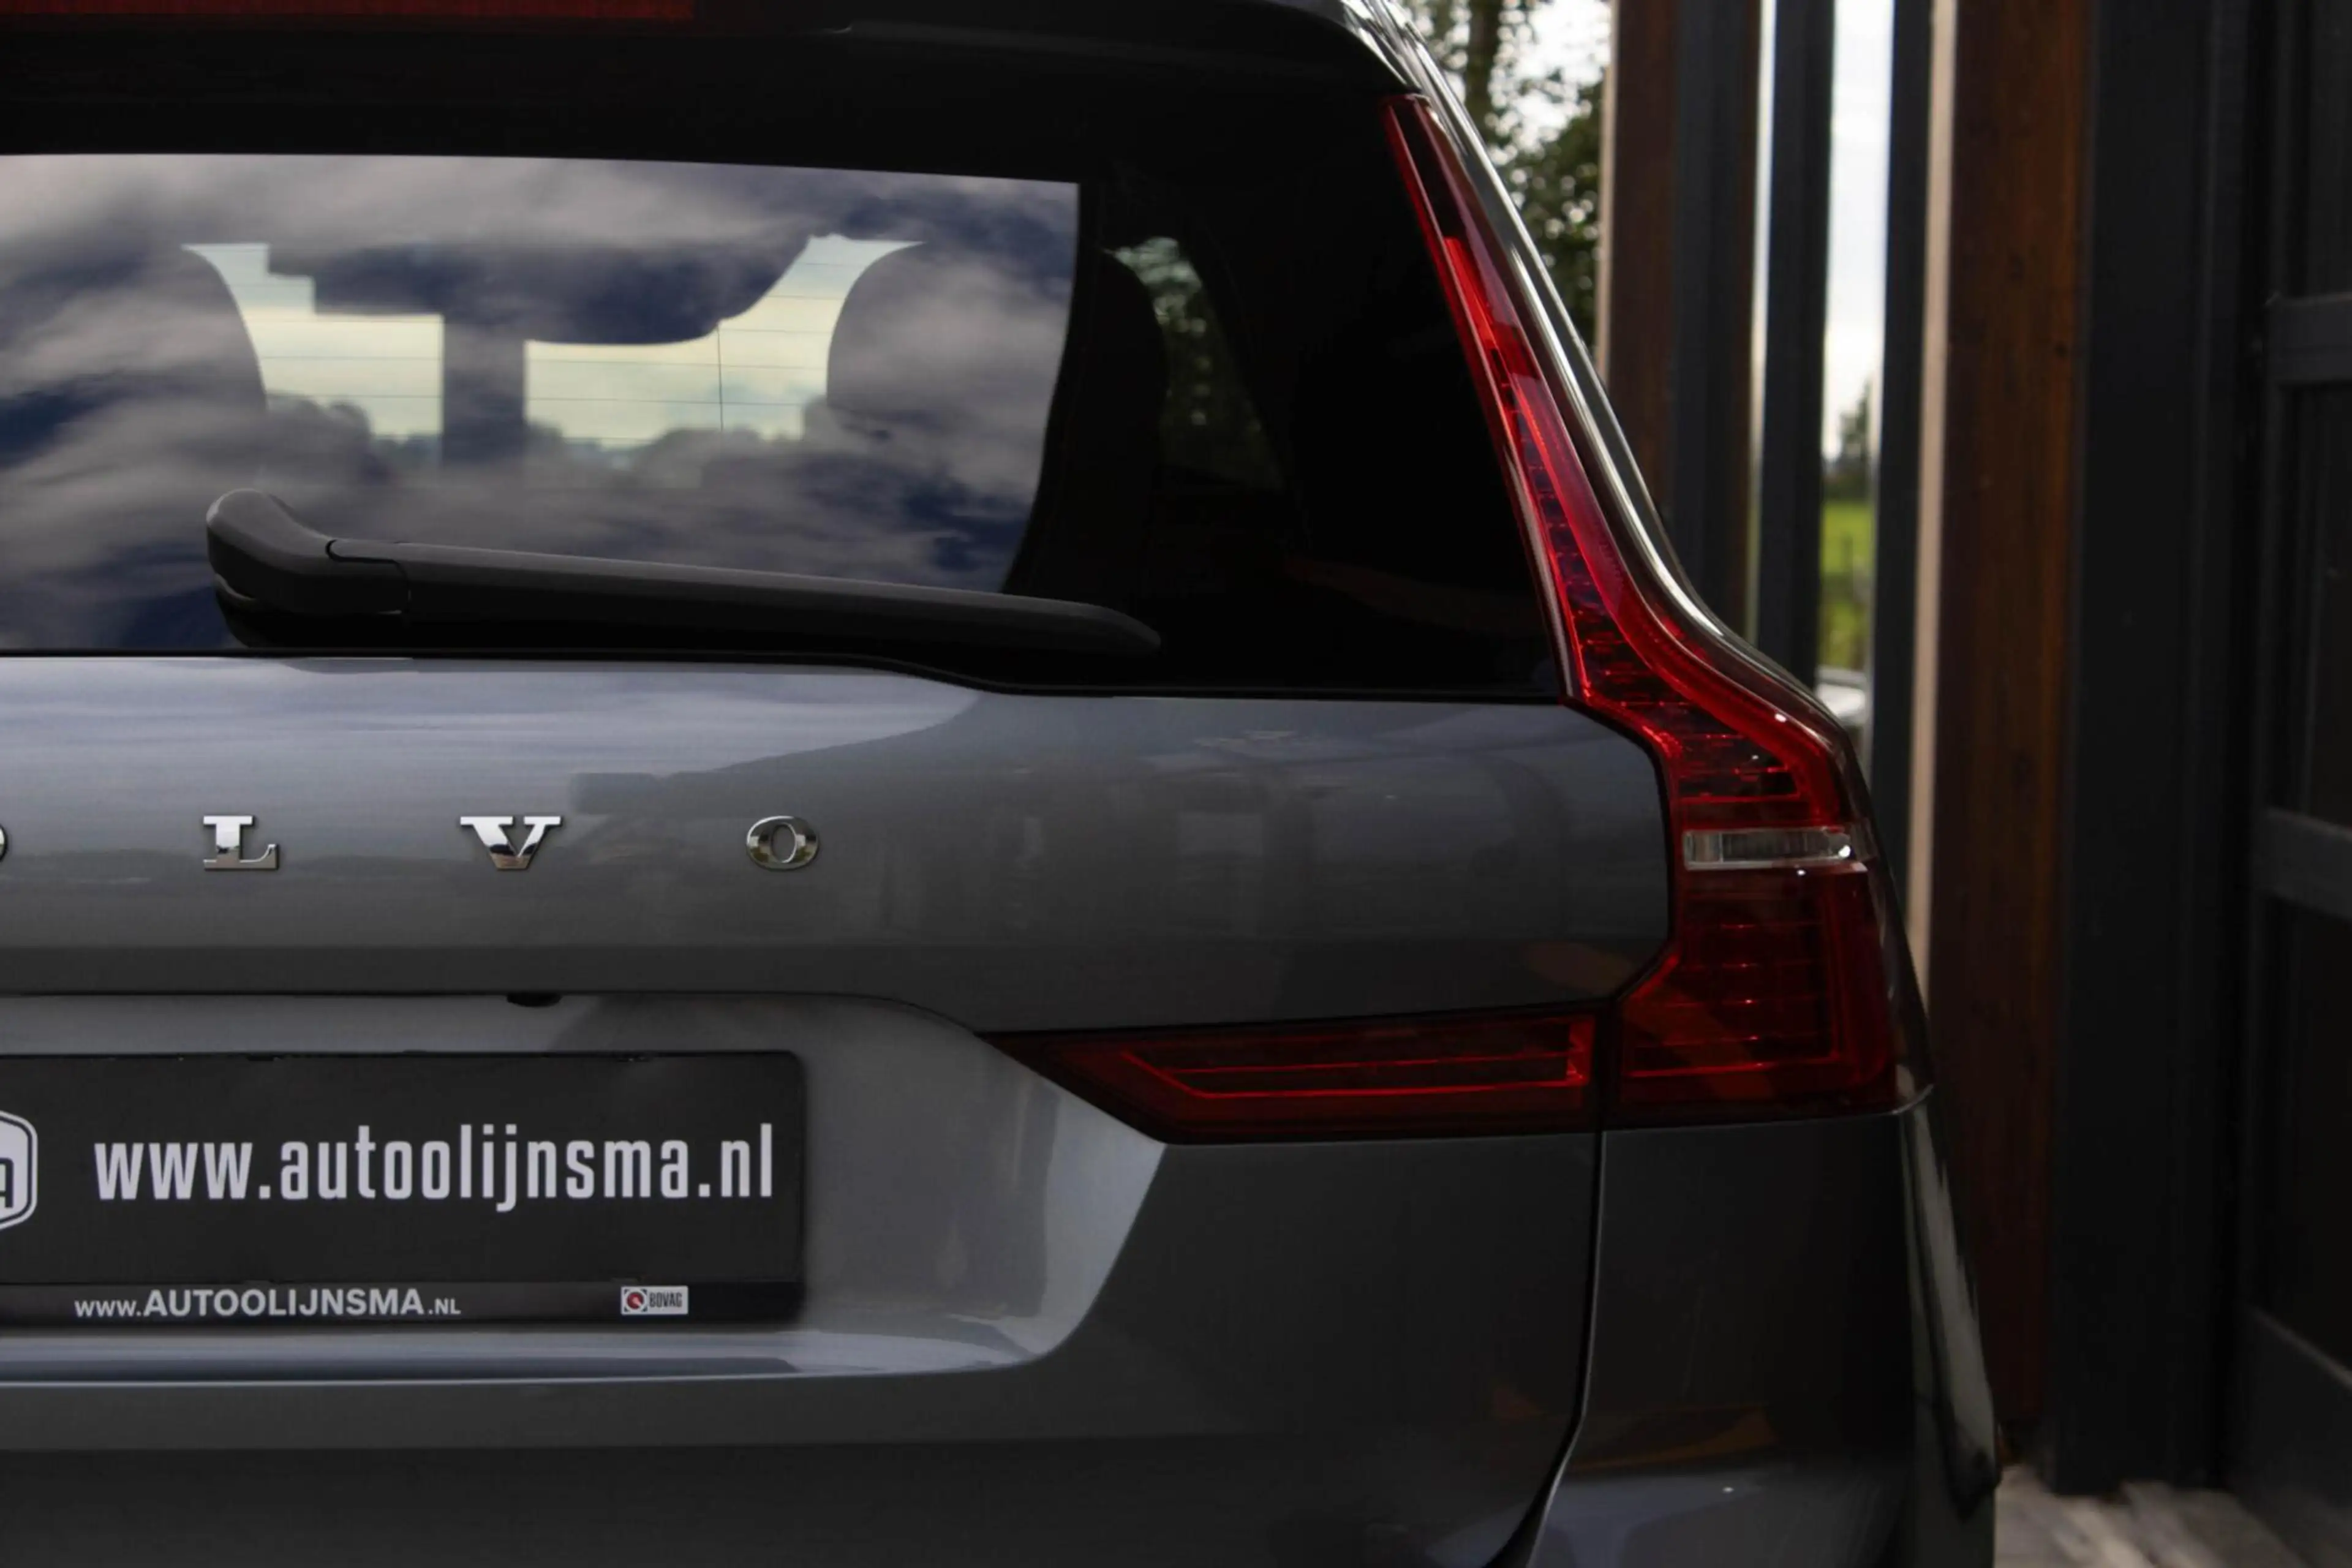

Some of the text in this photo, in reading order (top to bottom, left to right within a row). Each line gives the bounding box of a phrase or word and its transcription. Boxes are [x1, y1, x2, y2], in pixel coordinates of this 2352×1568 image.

[0, 815, 820, 870] LVO
[94, 1123, 772, 1212] www.autoolijnsma.nl
[74, 1288, 461, 1317] www.AUTOOLIJNSMA.NL
[649, 1291, 682, 1308] BOVAG
